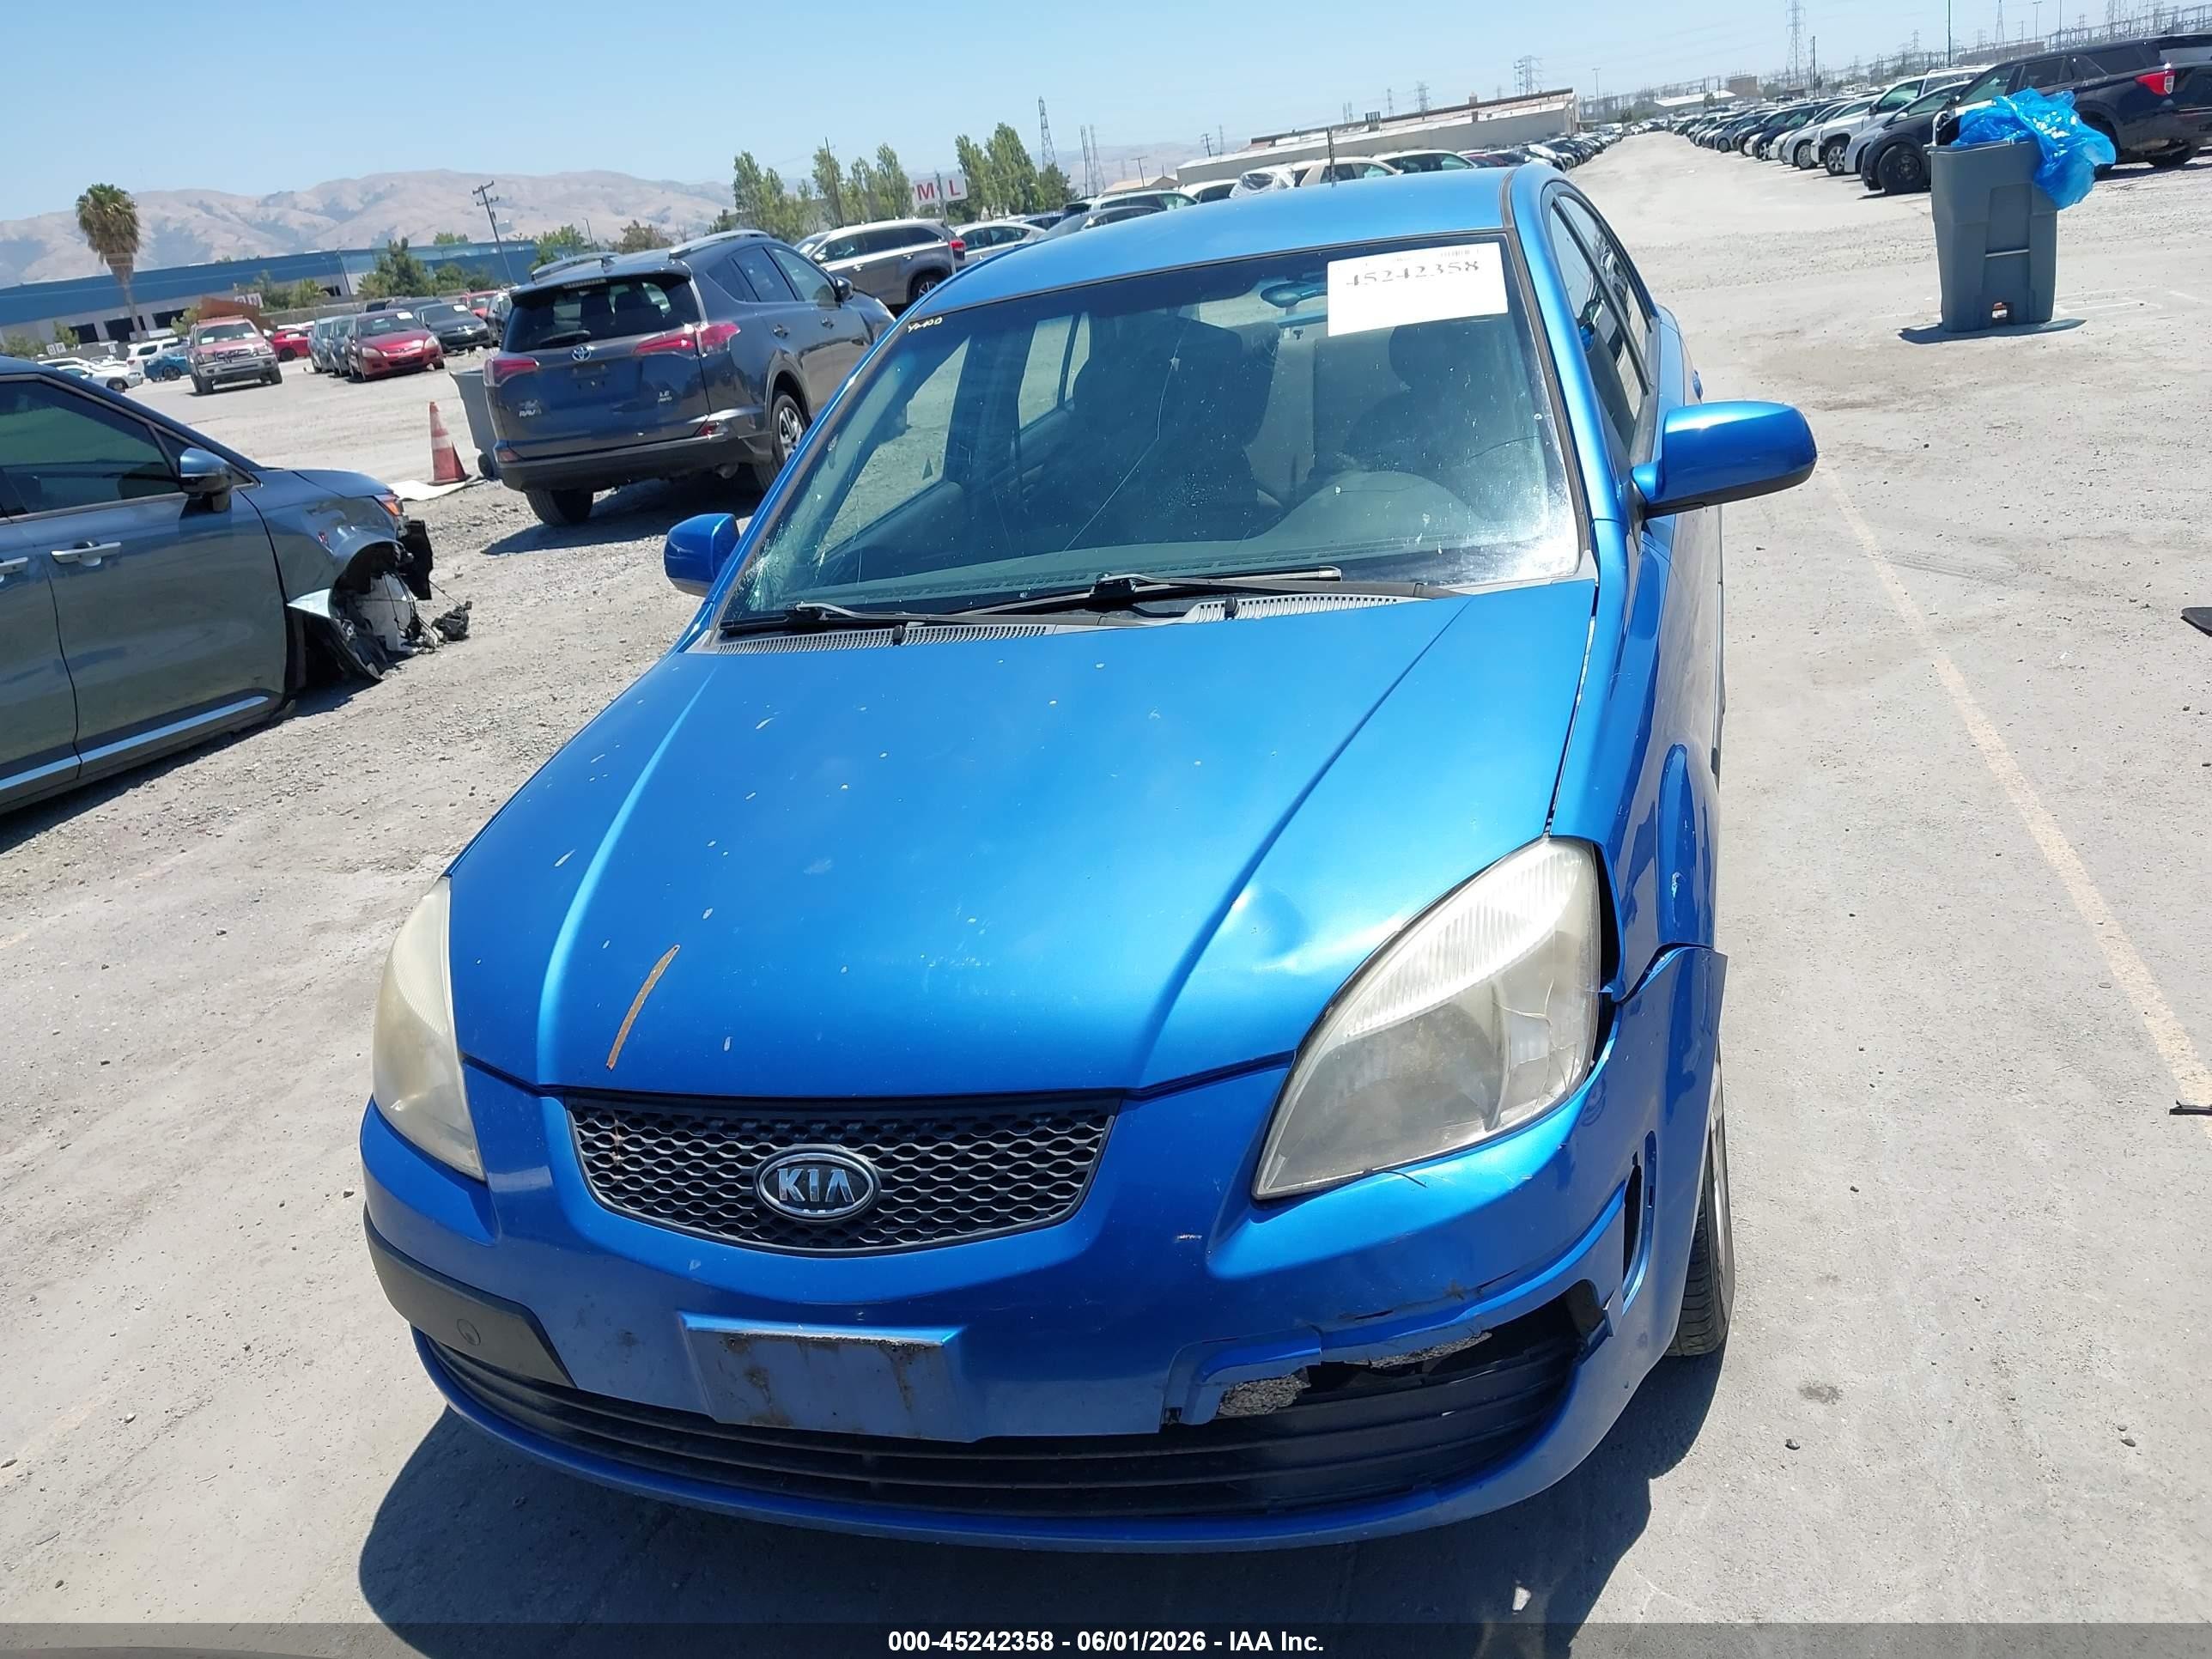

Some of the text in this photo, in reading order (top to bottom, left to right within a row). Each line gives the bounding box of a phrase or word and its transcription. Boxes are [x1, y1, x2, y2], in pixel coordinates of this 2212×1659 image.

[916, 182, 935, 201] M
[949, 179, 961, 197] L
[776, 1168, 856, 1202] KIA
